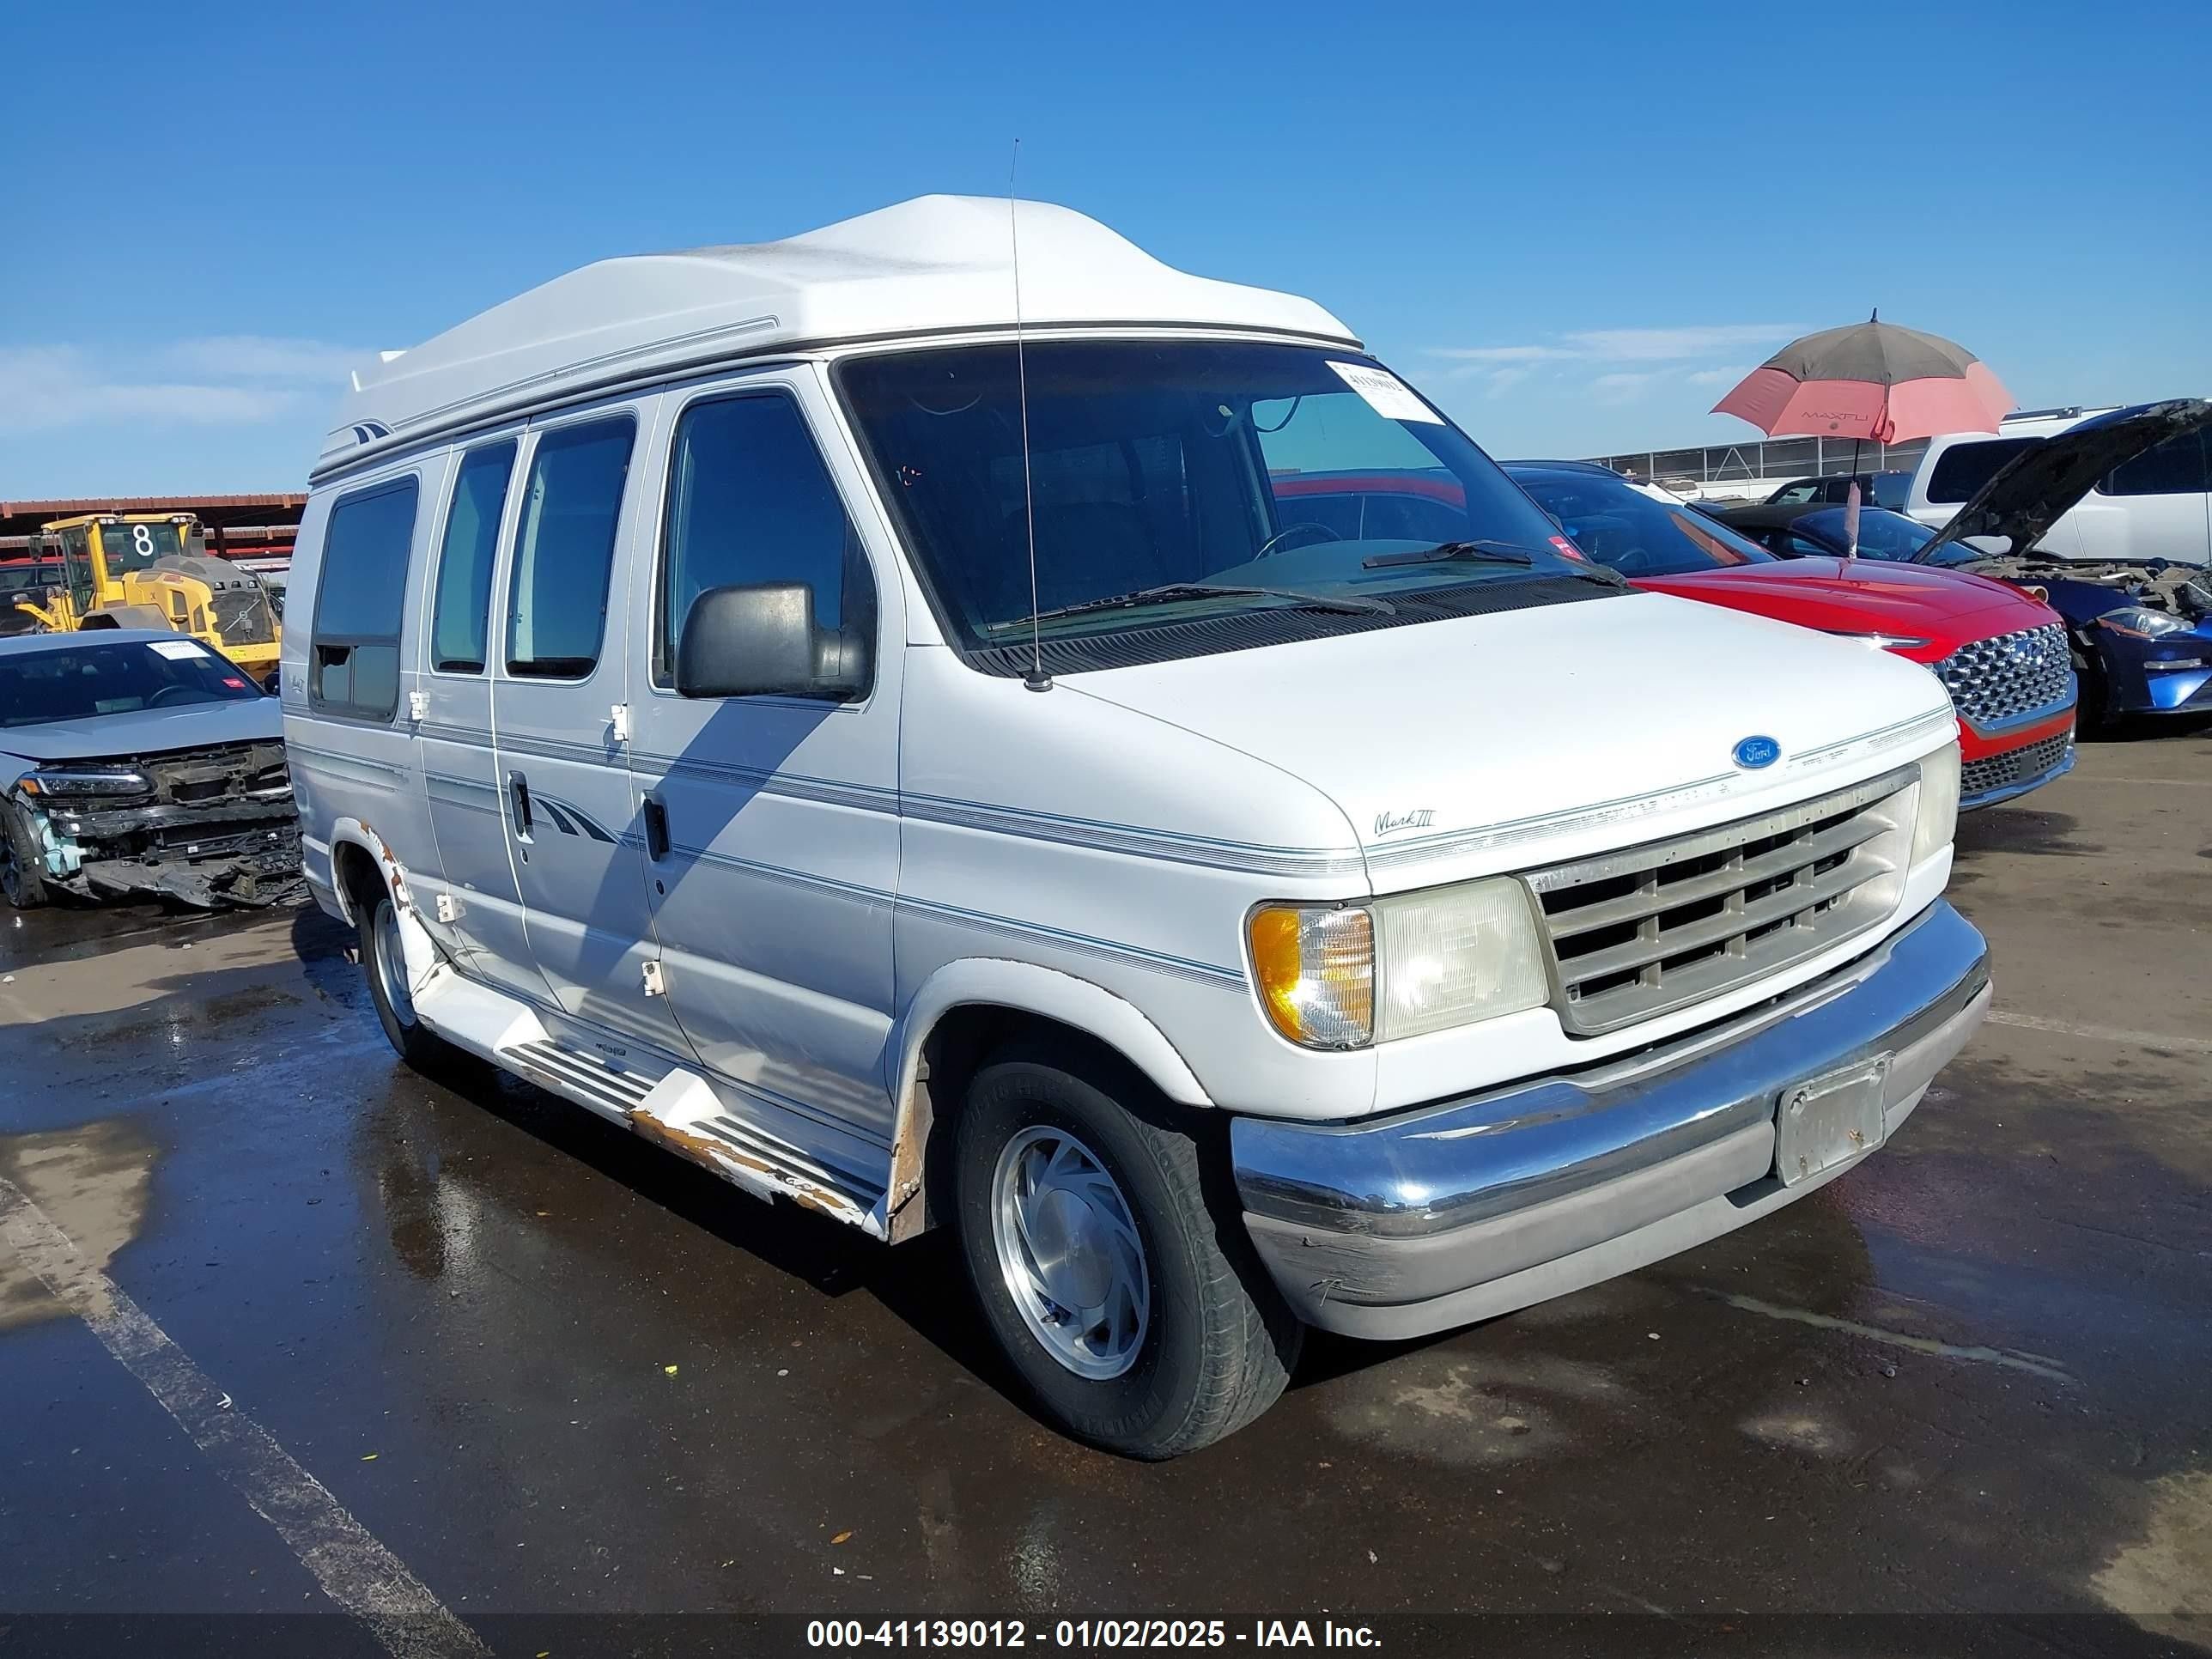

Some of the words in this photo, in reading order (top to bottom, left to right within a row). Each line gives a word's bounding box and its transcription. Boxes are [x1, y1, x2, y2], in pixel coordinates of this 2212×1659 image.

[132, 524, 155, 556] 8
[1746, 741, 1771, 762] Ford
[1374, 810, 1416, 834] Mark
